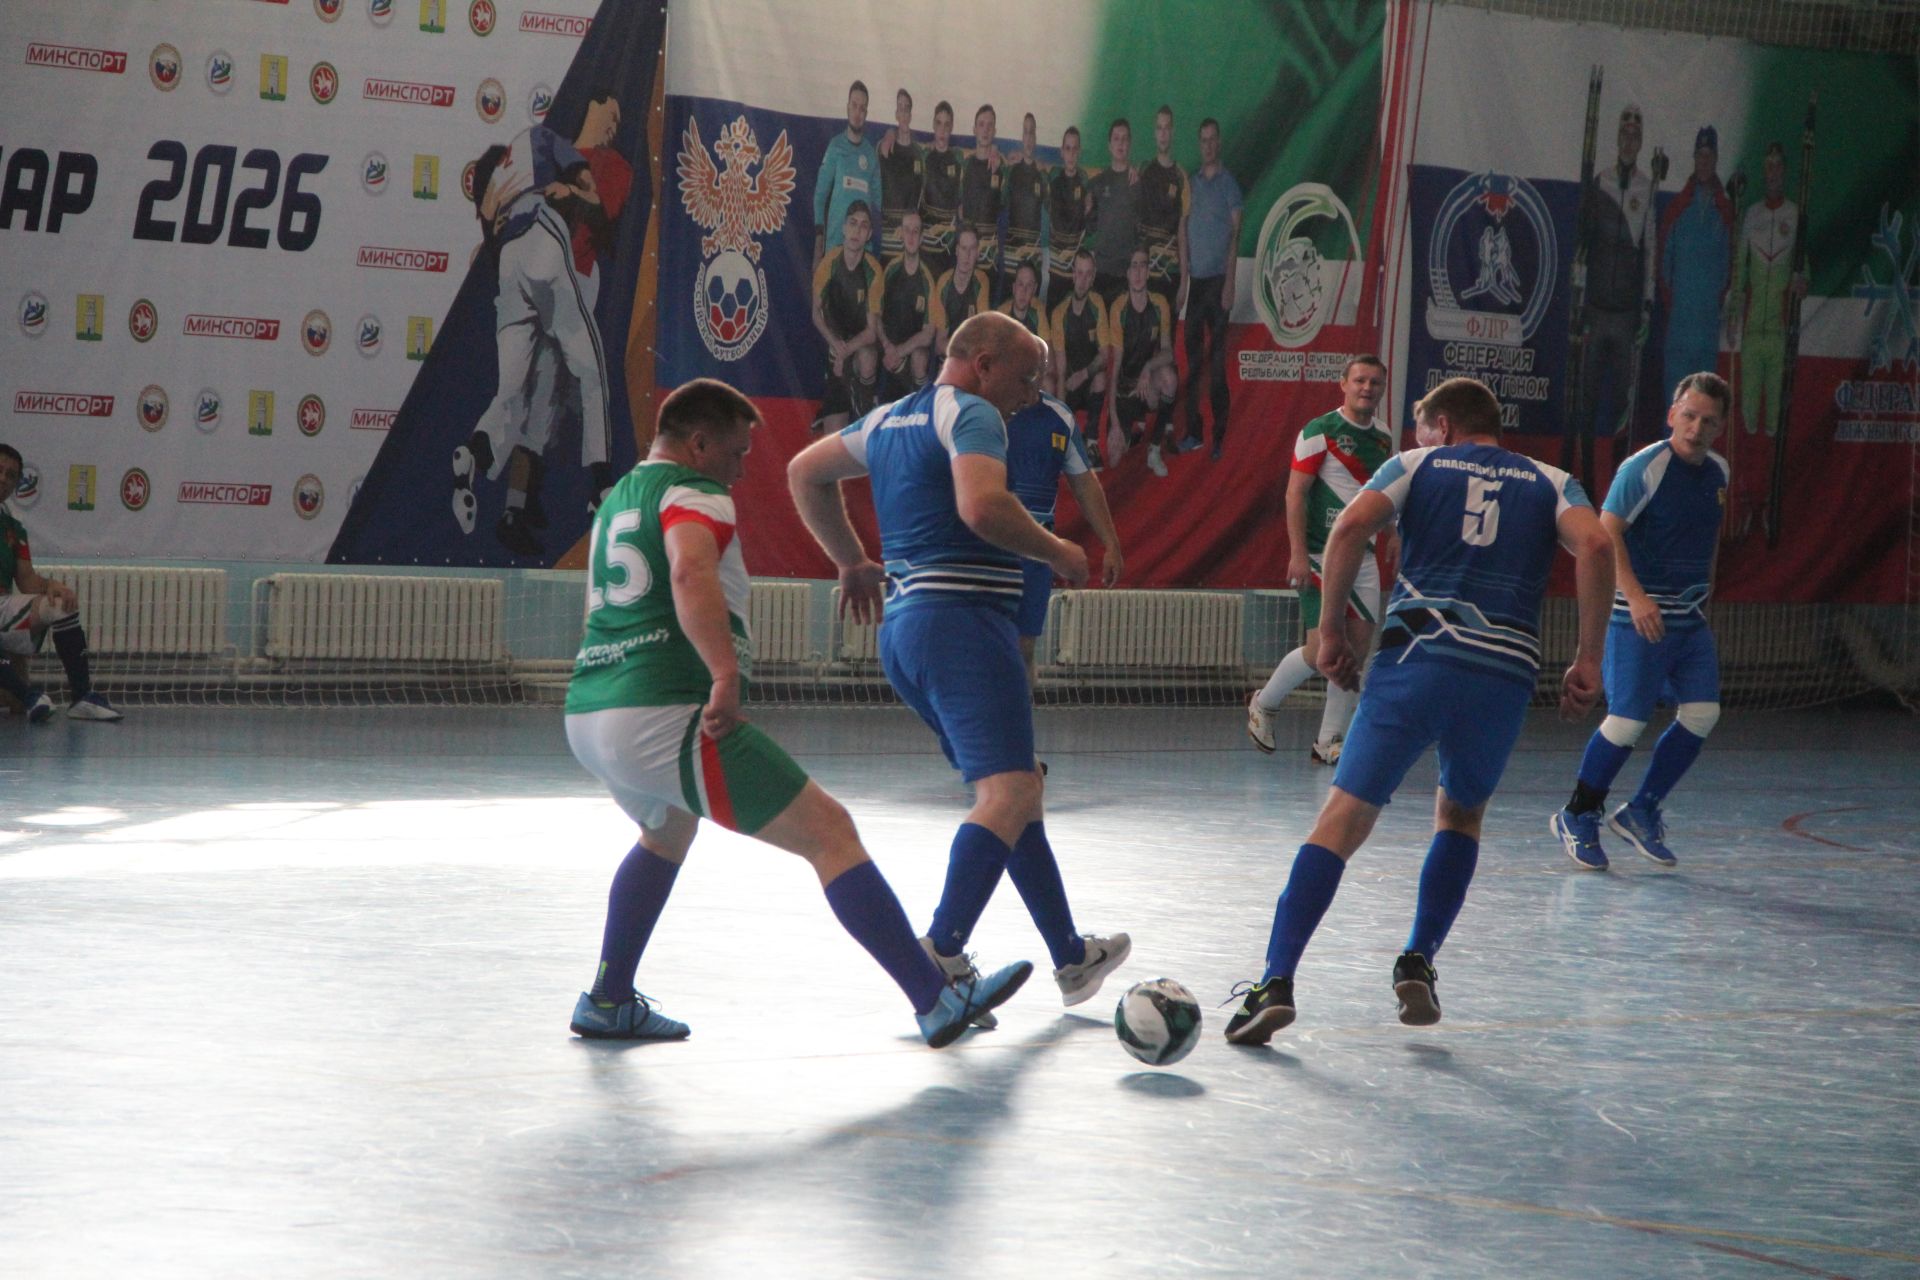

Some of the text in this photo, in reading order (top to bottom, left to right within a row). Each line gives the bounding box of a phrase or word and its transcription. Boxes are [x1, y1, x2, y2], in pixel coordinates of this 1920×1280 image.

[28, 46, 125, 72] МИНСПОРТ
[366, 81, 454, 105] МИНСПОРТ
[0, 140, 329, 251] АР 2026
[359, 249, 448, 271] МИНСПОРТ
[187, 317, 278, 338] МИНСПОРТ
[1240, 353, 1352, 365] ФЕДЕРАЦИЯ ФУТБОЛ
[1445, 344, 1533, 370] ФЕДЕРАЦИЯ
[1241, 366, 1342, 380] РЕСПУБЛИКИ ТАТАРСТ
[1502, 375, 1548, 399] ГОНОК
[1836, 382, 1920, 413] ФЕДЕРА
[17, 395, 112, 415] МИНСПОРТ
[353, 413, 396, 429] МИНС
[1433, 458, 1537, 482] СПАССКИЙ РАЙОН
[181, 484, 271, 504] МИНСПОРТ
[1462, 476, 1504, 547] 5
